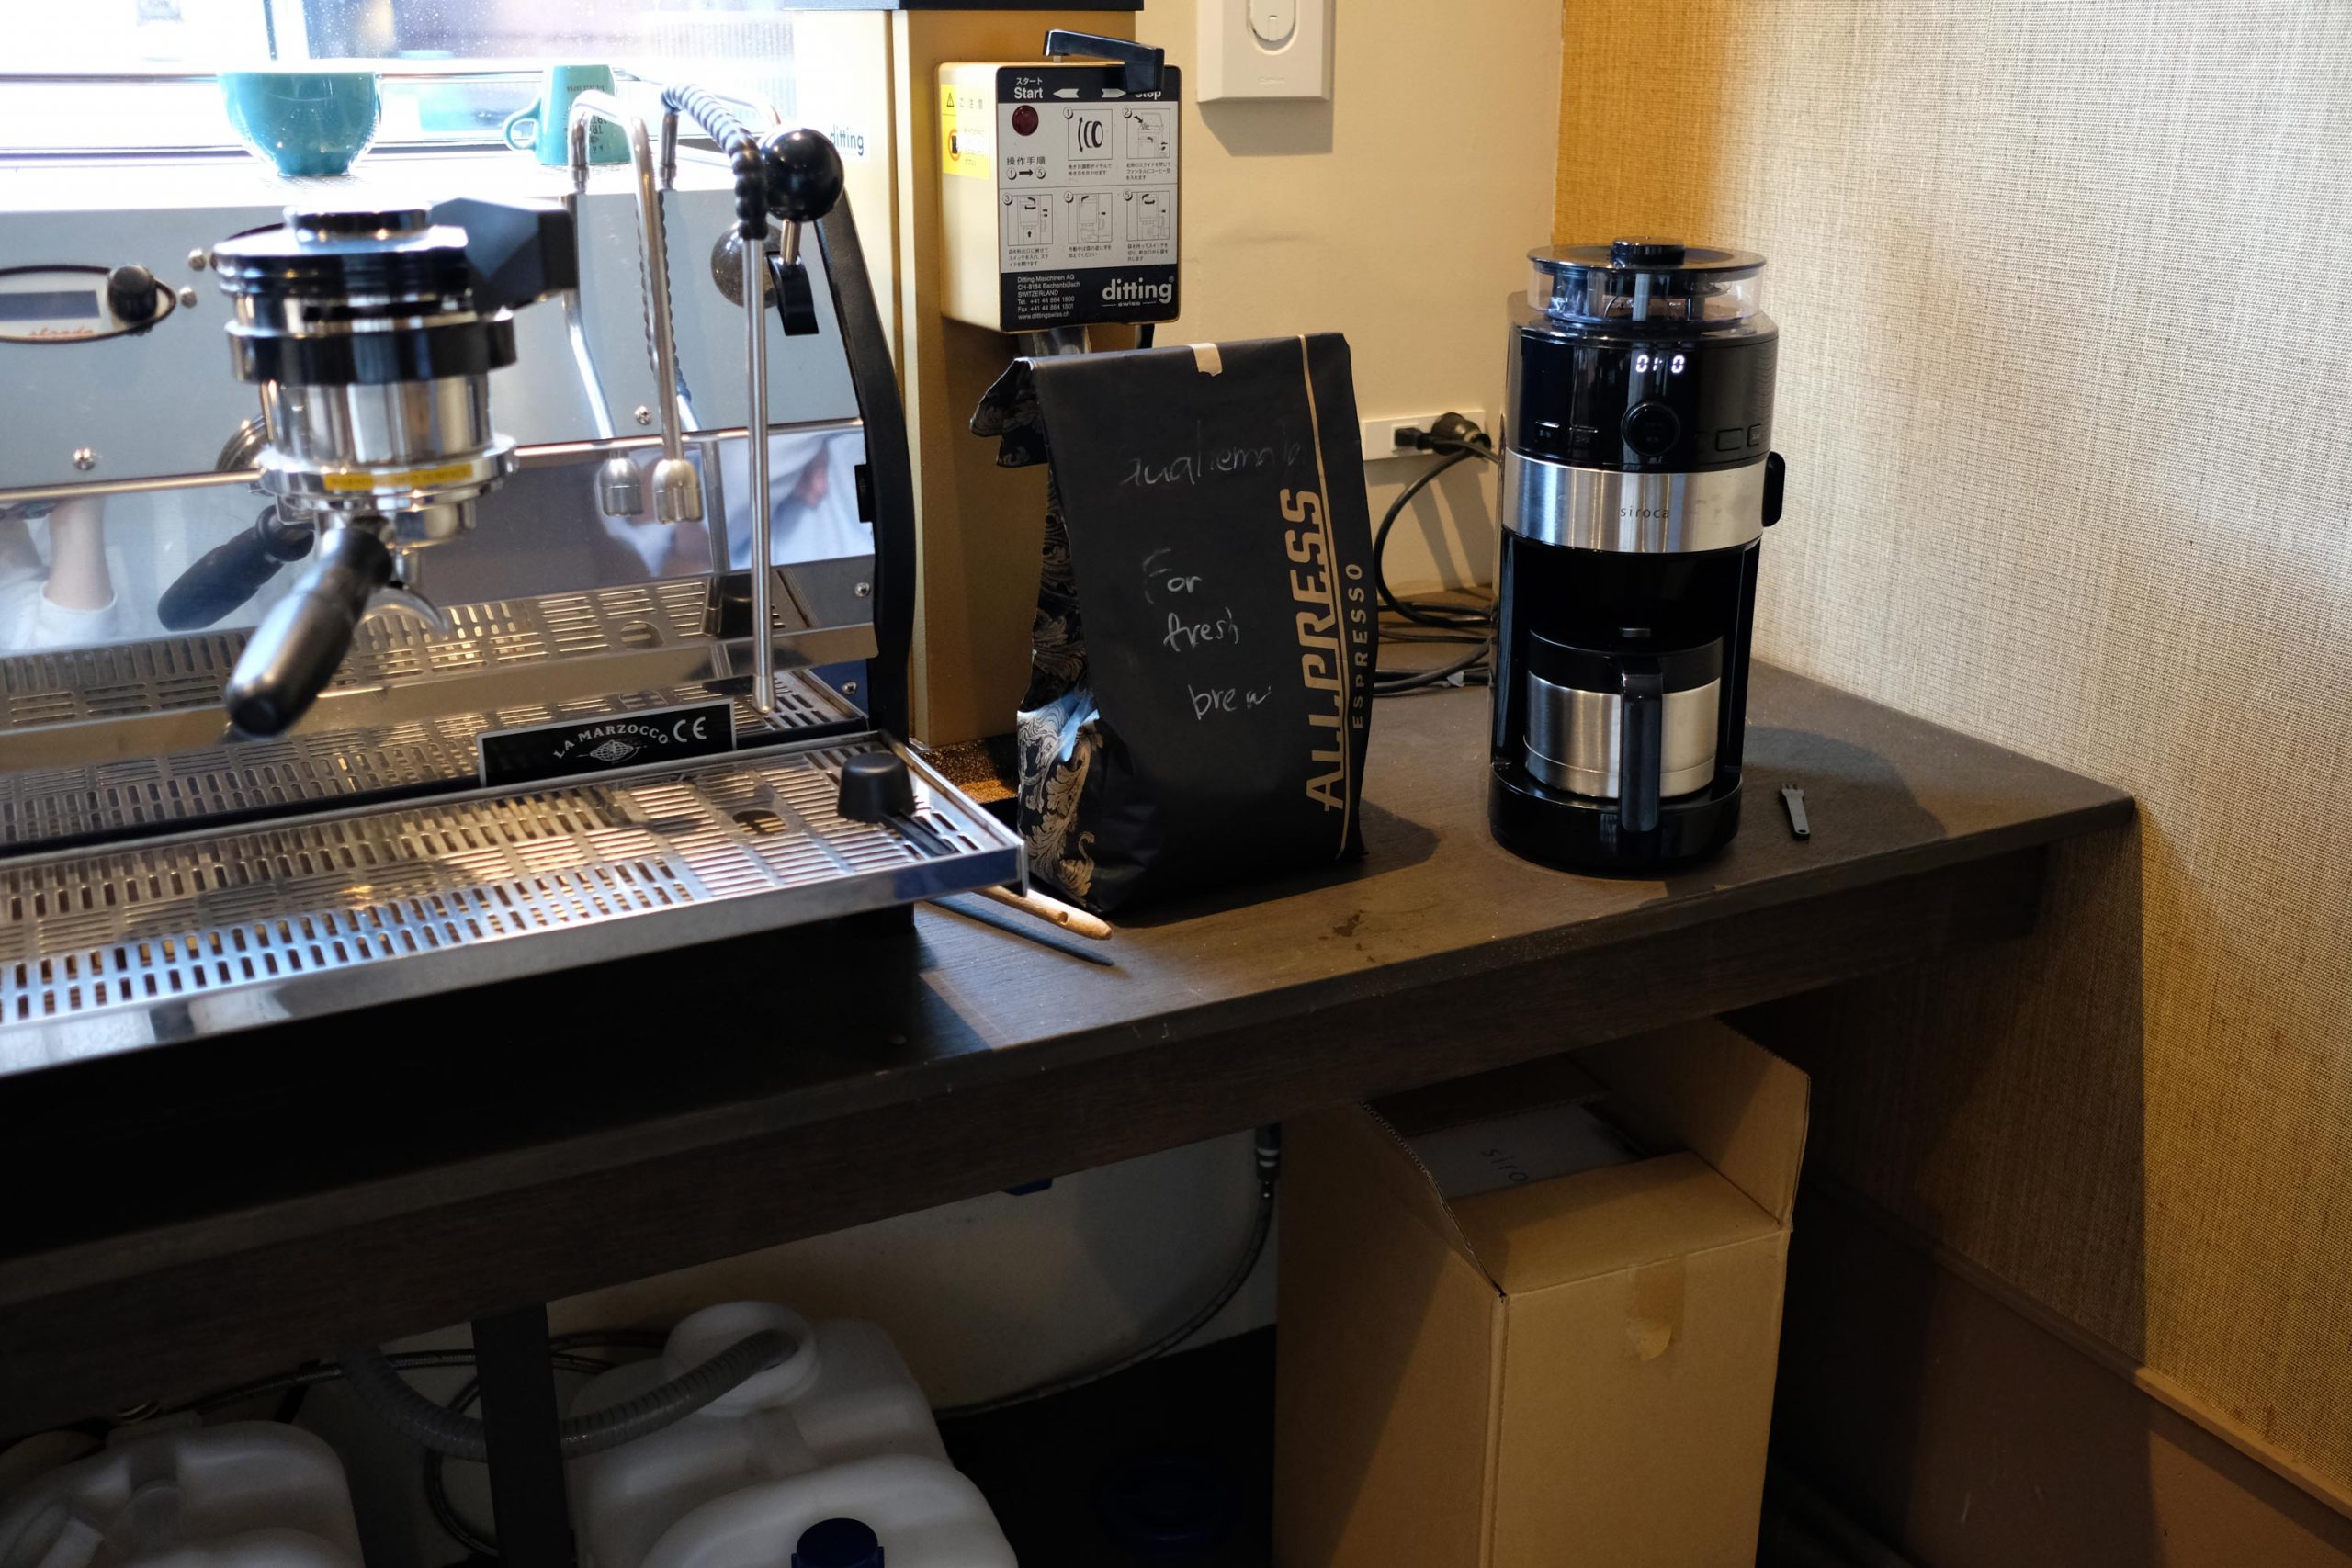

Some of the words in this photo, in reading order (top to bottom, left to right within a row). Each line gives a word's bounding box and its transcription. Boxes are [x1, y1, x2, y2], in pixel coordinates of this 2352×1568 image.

[1014, 87, 1043, 99] Start
[1016, 76, 1043, 85] スタート
[830, 125, 864, 156] ditting
[1006, 156, 1046, 166] 操作手順
[1017, 289, 1058, 298] SWITZERLAND
[1102, 277, 1172, 304] ditting
[1620, 505, 1669, 519] siroca
[1142, 548, 1202, 604] For
[1163, 607, 1239, 652] fresh
[1280, 488, 1344, 813] ALLPRESS
[1345, 564, 1369, 729] ESPRESSO
[1188, 684, 1272, 720] brew
[553, 739, 575, 760] LA
[576, 723, 669, 745] MARZOCCO
[673, 716, 707, 743] CE
[1480, 1145, 1529, 1183] siro
